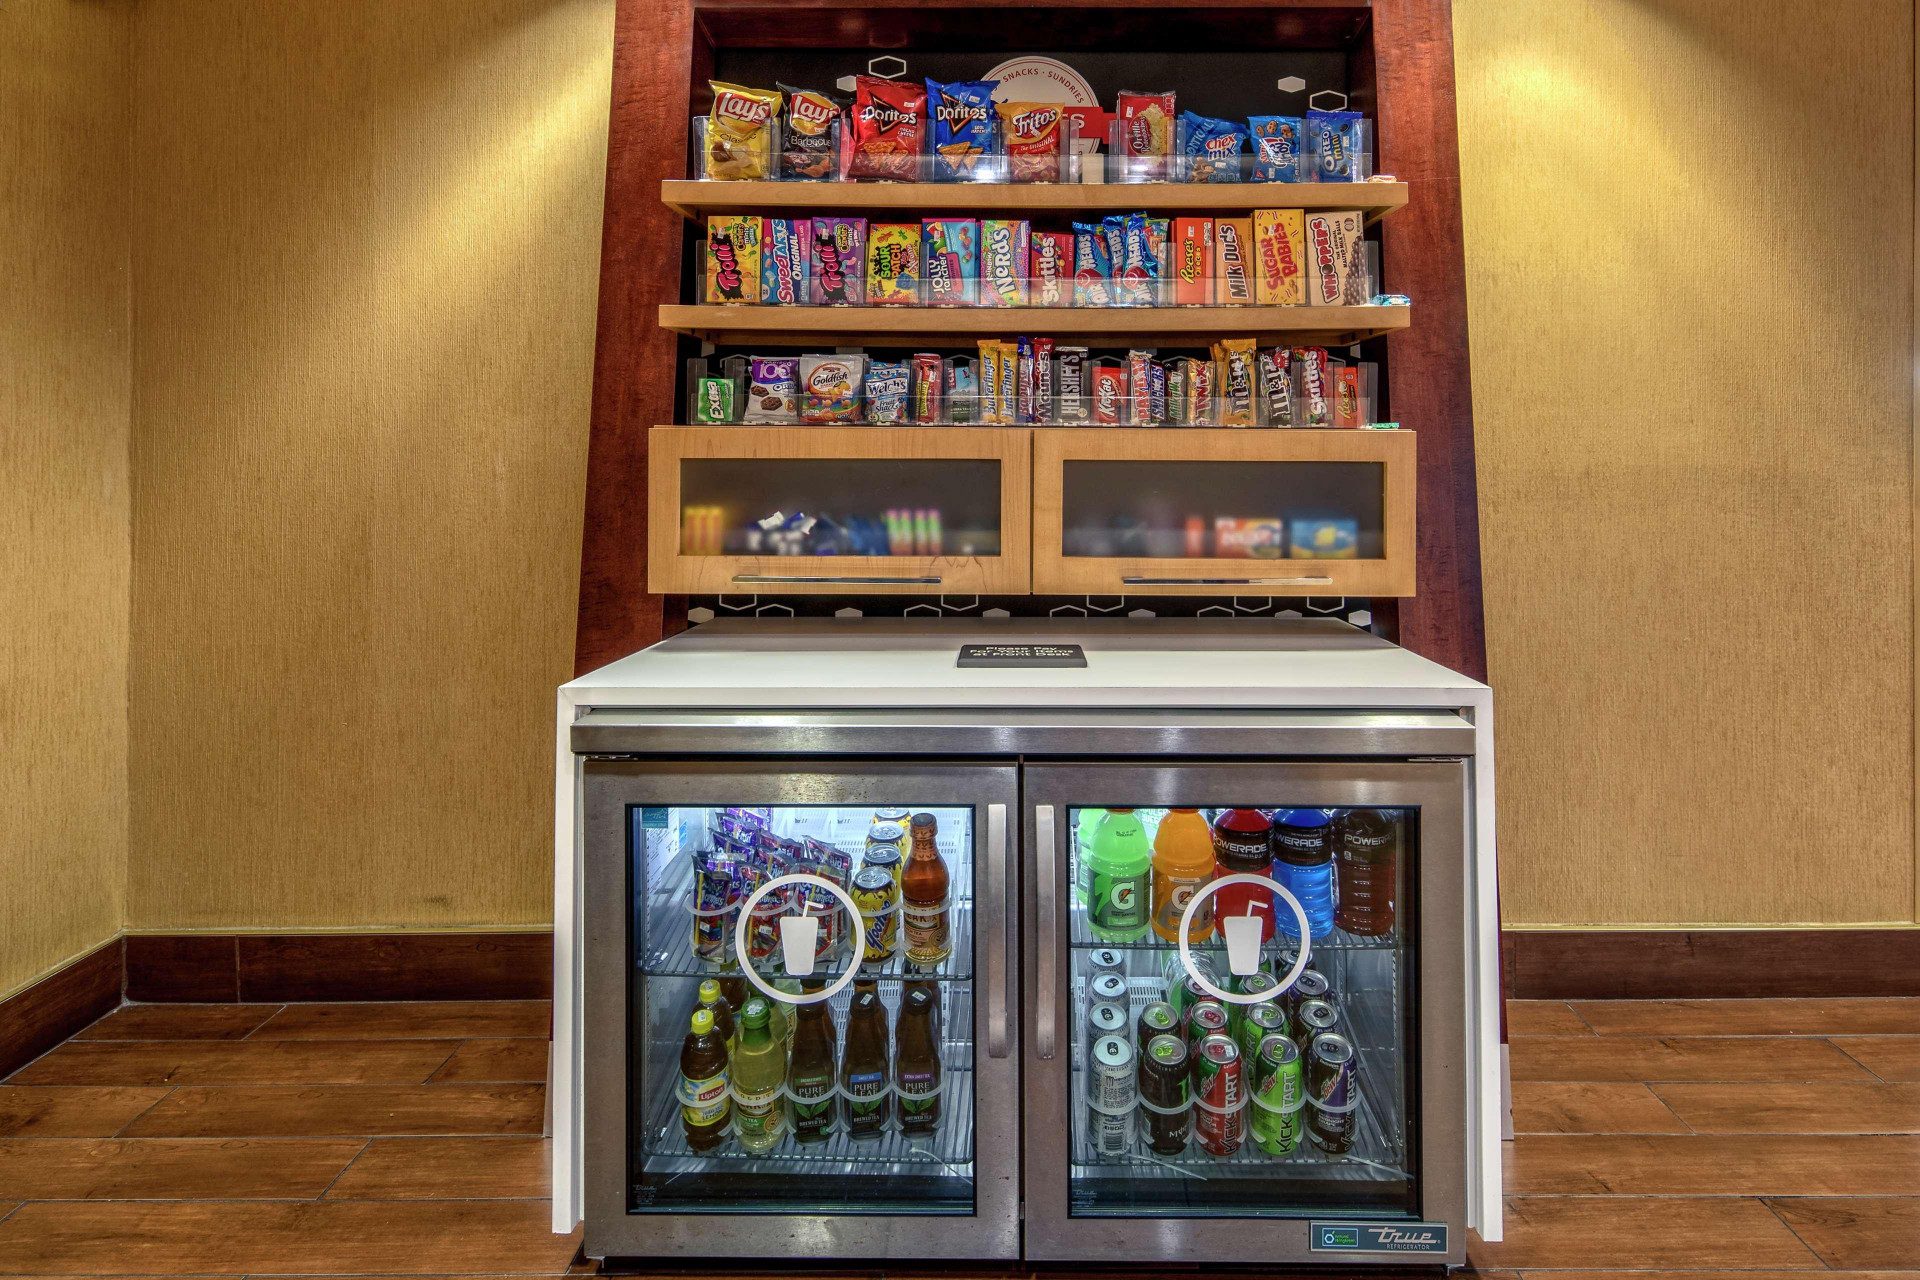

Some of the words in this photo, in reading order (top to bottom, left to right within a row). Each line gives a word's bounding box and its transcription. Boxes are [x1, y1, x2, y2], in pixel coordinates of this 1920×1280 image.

[1003, 68, 1039, 83] SNACKS
[1047, 71, 1085, 104] SUNDRIES
[718, 93, 770, 122] Lay's
[860, 105, 917, 124] Doritos
[936, 105, 987, 121] Doritos
[1013, 109, 1056, 137] Fritos
[1132, 121, 1144, 149] Orville
[1205, 133, 1236, 150] Chex
[1208, 144, 1235, 160] mix
[1321, 131, 1336, 173] OREO
[1332, 134, 1344, 160] mini
[790, 235, 802, 281] ORIGINAL
[880, 247, 891, 278] SOUR
[890, 244, 901, 279] PATCH
[1260, 237, 1285, 290] SUGAR
[1274, 222, 1299, 278] BABIES
[1312, 219, 1338, 300] WHOPPERS
[711, 243, 740, 291] Trolli
[814, 244, 843, 291] Trolli
[929, 260, 944, 293] JOLLY
[813, 366, 848, 387] Goldfish
[868, 380, 906, 395] Welch's
[984, 355, 996, 414] Butterfinger
[1002, 358, 1014, 417] Butterfinger
[1061, 355, 1079, 414] HERSHEY'S
[1303, 351, 1327, 415] Skittles
[1110, 881, 1136, 910] G
[700, 1086, 724, 1100] Lipton
[799, 1086, 825, 1095] PURE
[854, 1083, 879, 1091] PURE
[905, 1082, 930, 1090] PURE
